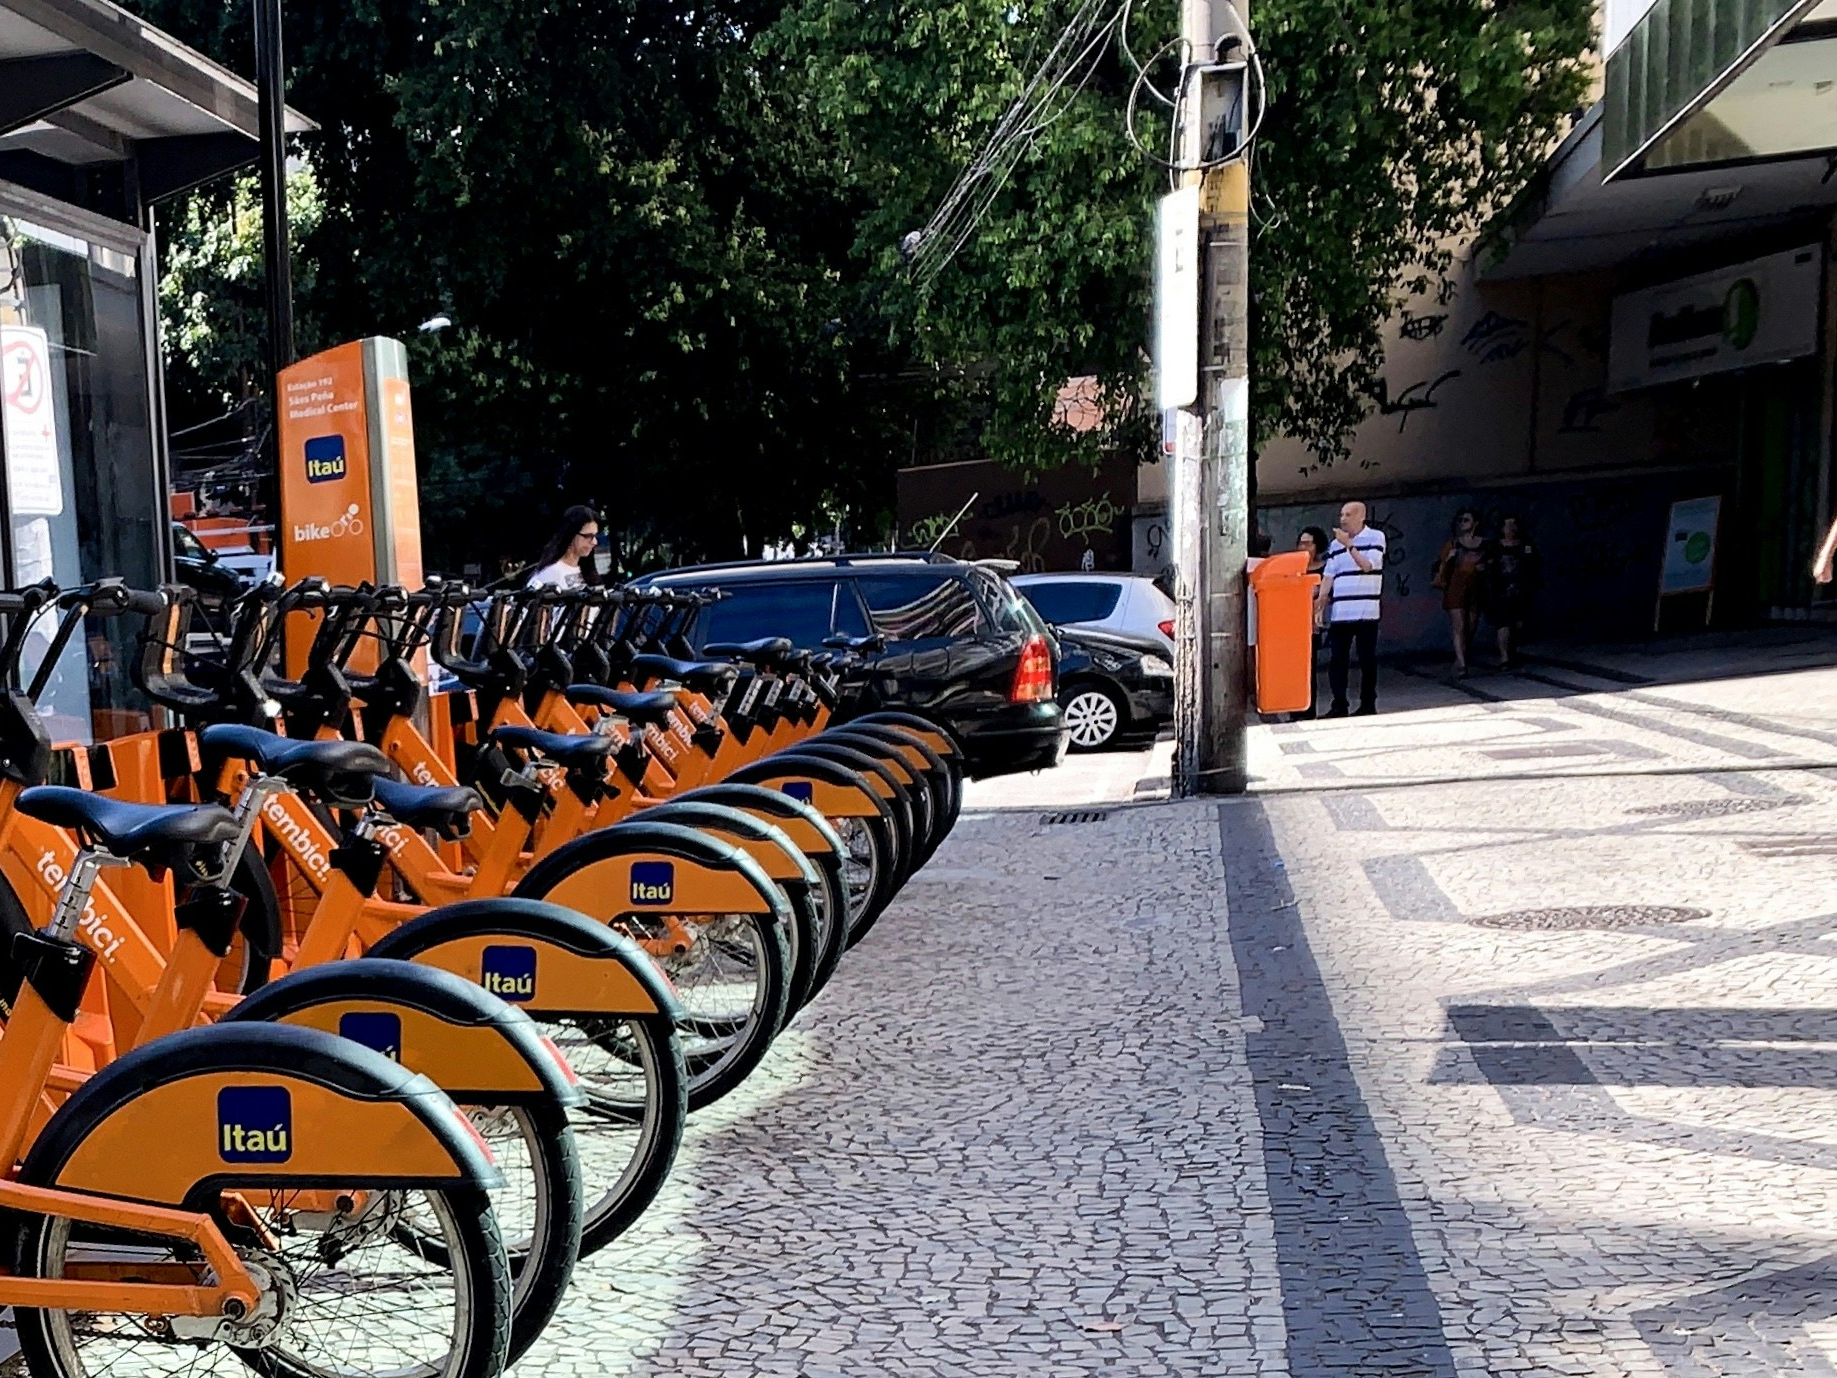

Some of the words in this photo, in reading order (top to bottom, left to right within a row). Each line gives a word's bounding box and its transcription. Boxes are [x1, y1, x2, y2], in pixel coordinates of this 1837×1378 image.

[289, 404, 326, 419] Medical
[327, 400, 359, 414] Center
[308, 456, 345, 478] Itaú
[294, 522, 331, 542] bike
[632, 882, 671, 900] Itaú
[485, 971, 533, 995] Itaú
[223, 1122, 288, 1152] Itaú
